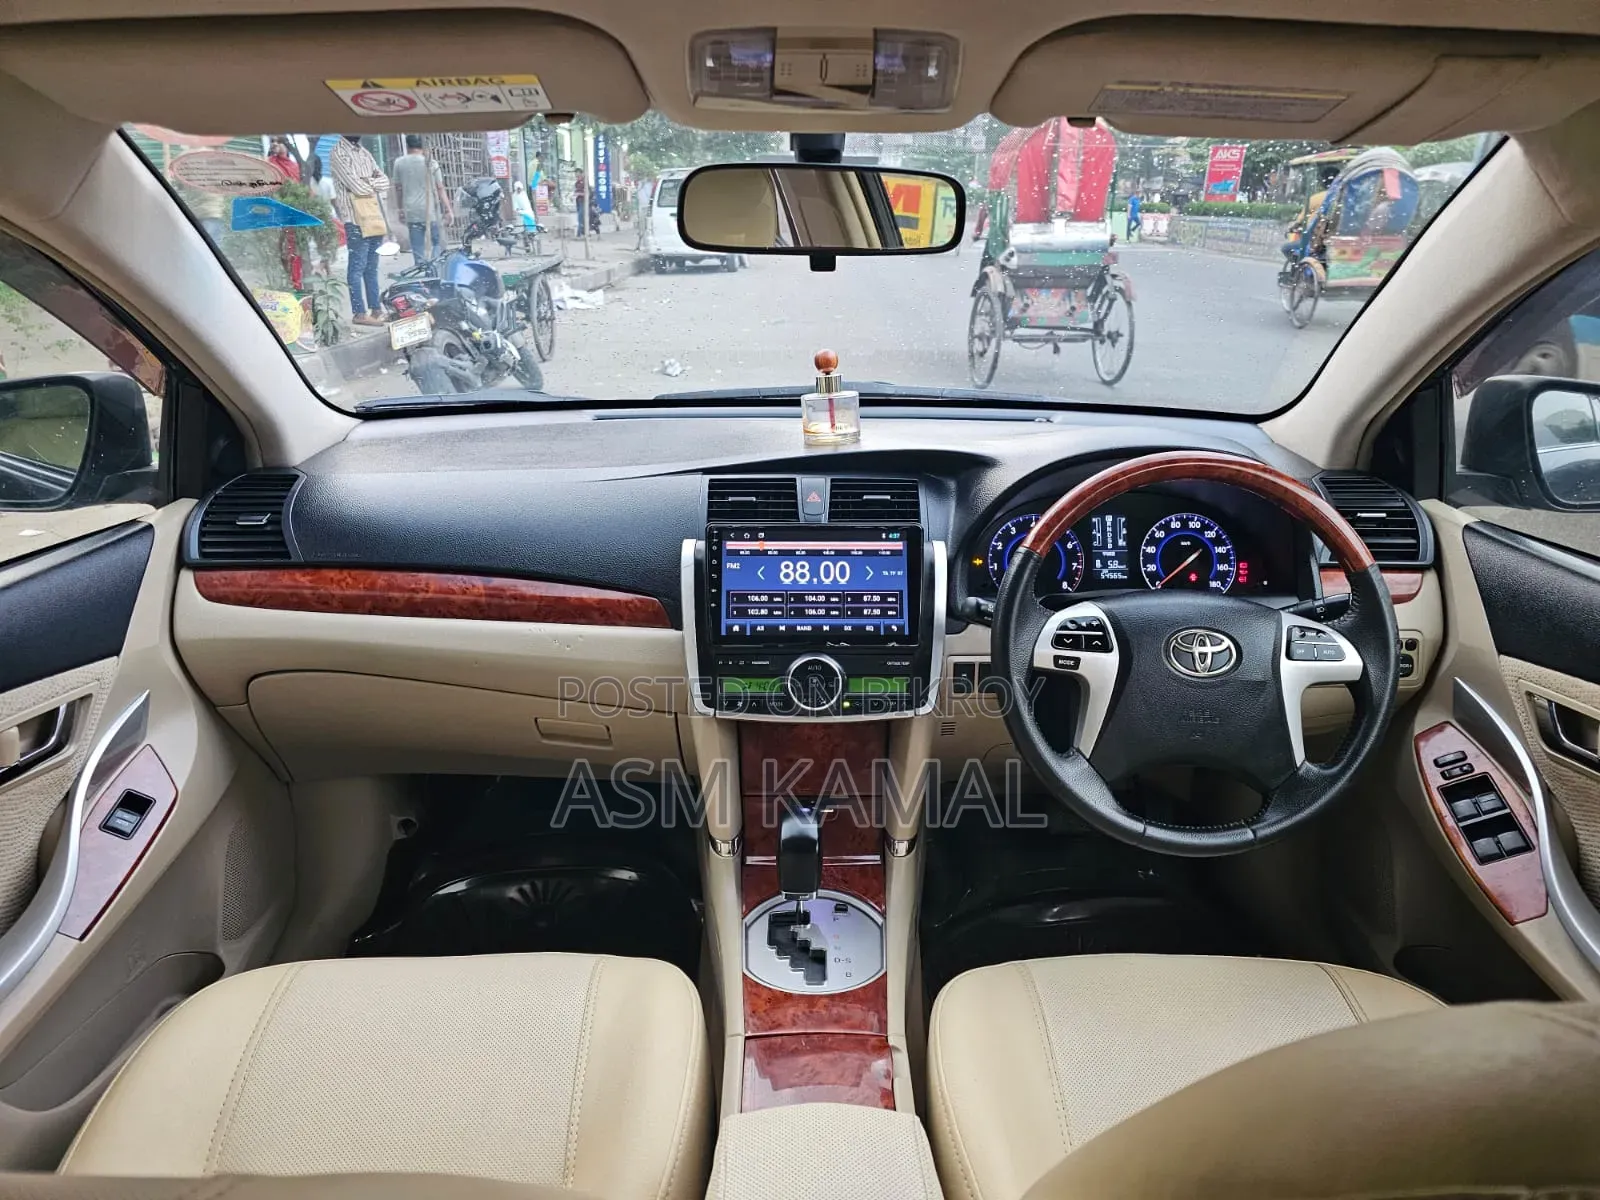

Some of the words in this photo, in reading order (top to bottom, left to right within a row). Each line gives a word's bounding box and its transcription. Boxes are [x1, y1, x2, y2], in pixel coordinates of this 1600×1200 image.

[414, 76, 506, 87] AIRBAG
[1215, 148, 1241, 159] AKS
[1170, 521, 1181, 529] 80
[1188, 521, 1201, 529] 100
[1010, 527, 1017, 535] 3
[1154, 530, 1165, 538] 60
[1204, 530, 1216, 538] 120
[996, 542, 1003, 550] 2
[1214, 546, 1227, 554] 140
[779, 560, 851, 584] 88.00
[1061, 581, 1068, 589] 8
